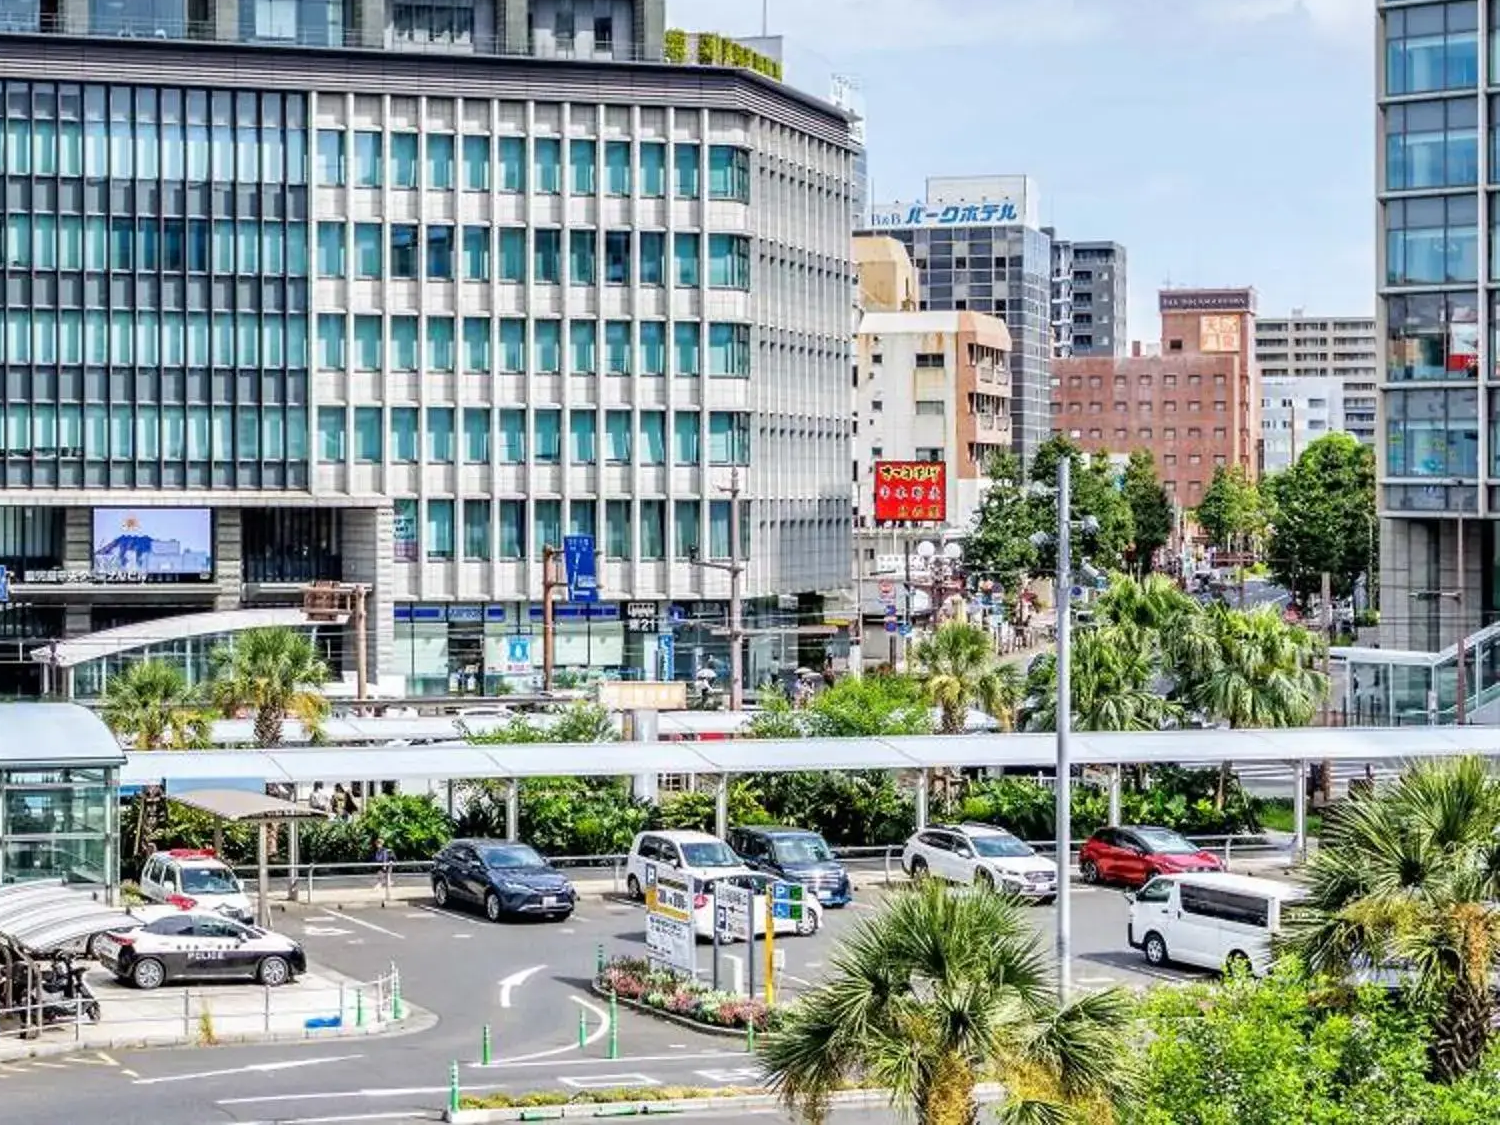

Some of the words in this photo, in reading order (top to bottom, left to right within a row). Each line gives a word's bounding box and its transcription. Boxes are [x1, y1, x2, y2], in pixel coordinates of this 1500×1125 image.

[905, 200, 1017, 224] パークホテル
